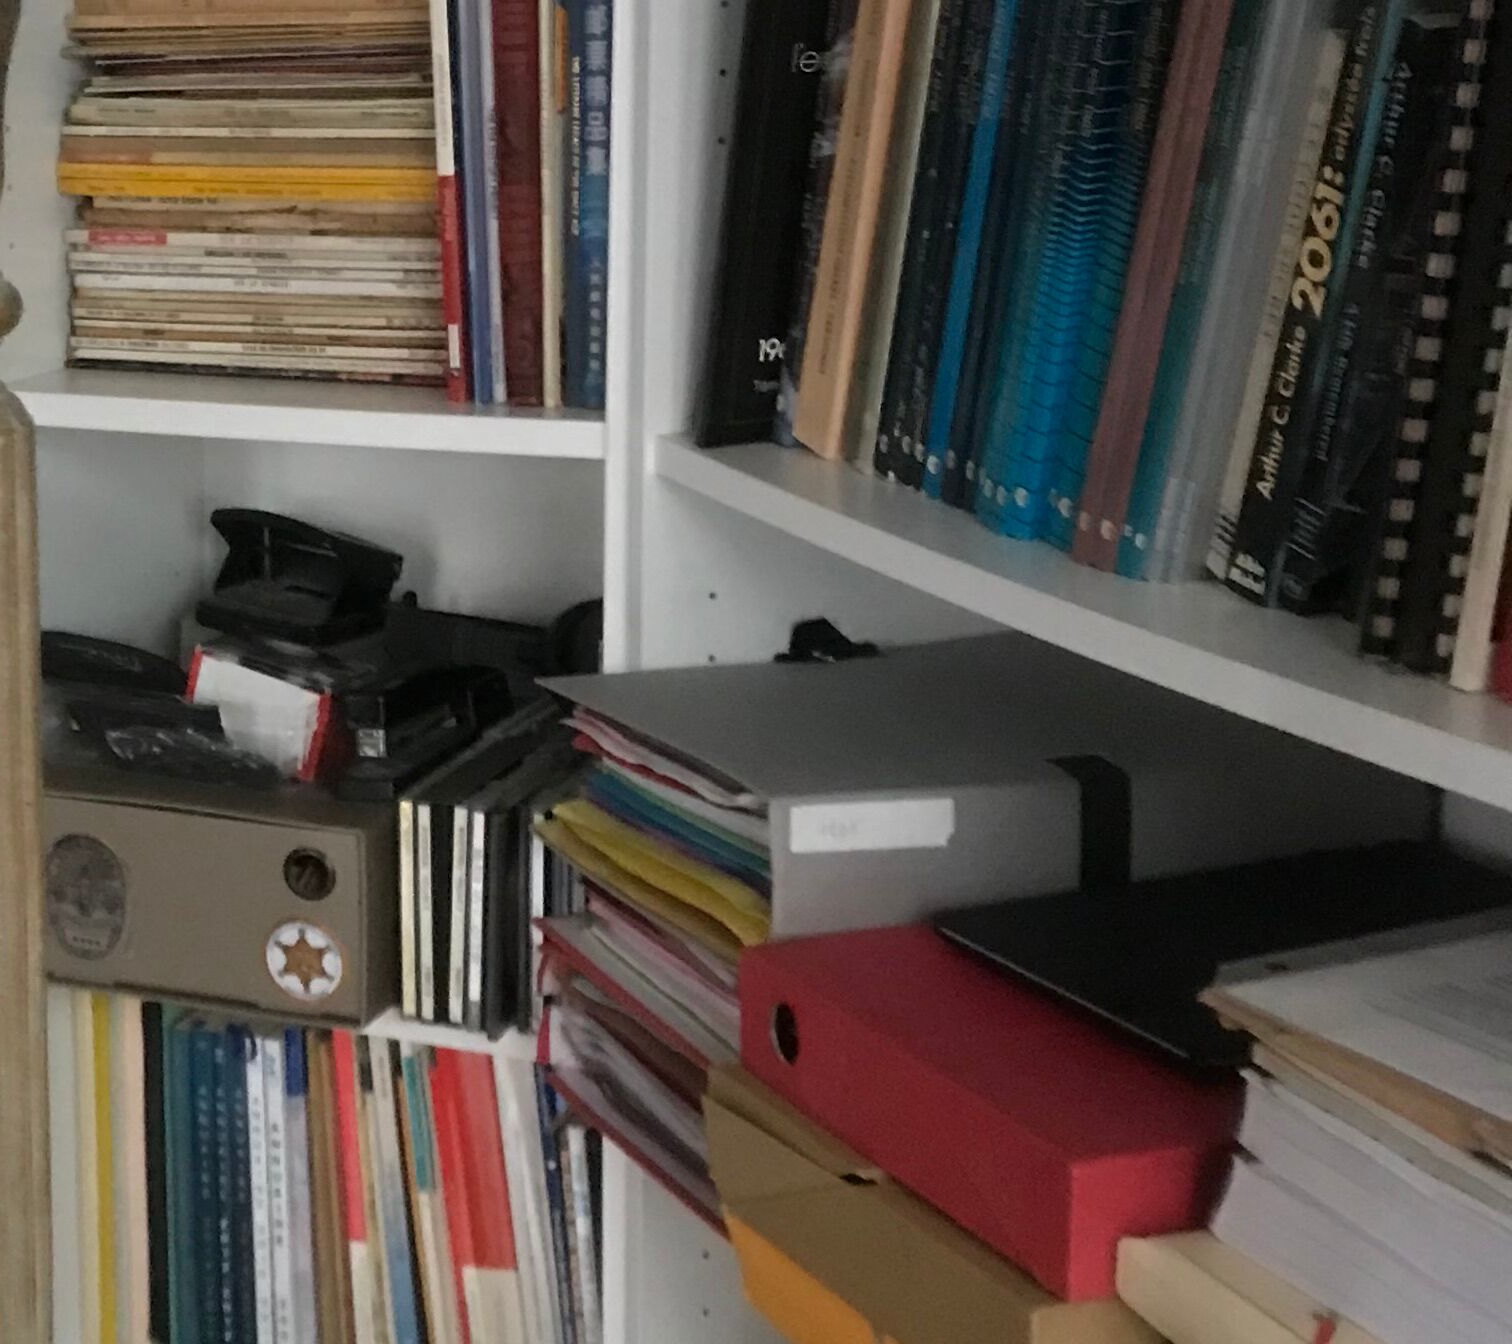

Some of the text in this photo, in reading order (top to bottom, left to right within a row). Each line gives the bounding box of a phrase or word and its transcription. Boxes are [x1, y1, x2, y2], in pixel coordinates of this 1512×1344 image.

[1291, 164, 1345, 318] 2061:
[1353, 187, 1389, 271] Clarke
[1275, 323, 1308, 399] Clarke
[1253, 427, 1286, 501] Arthur
